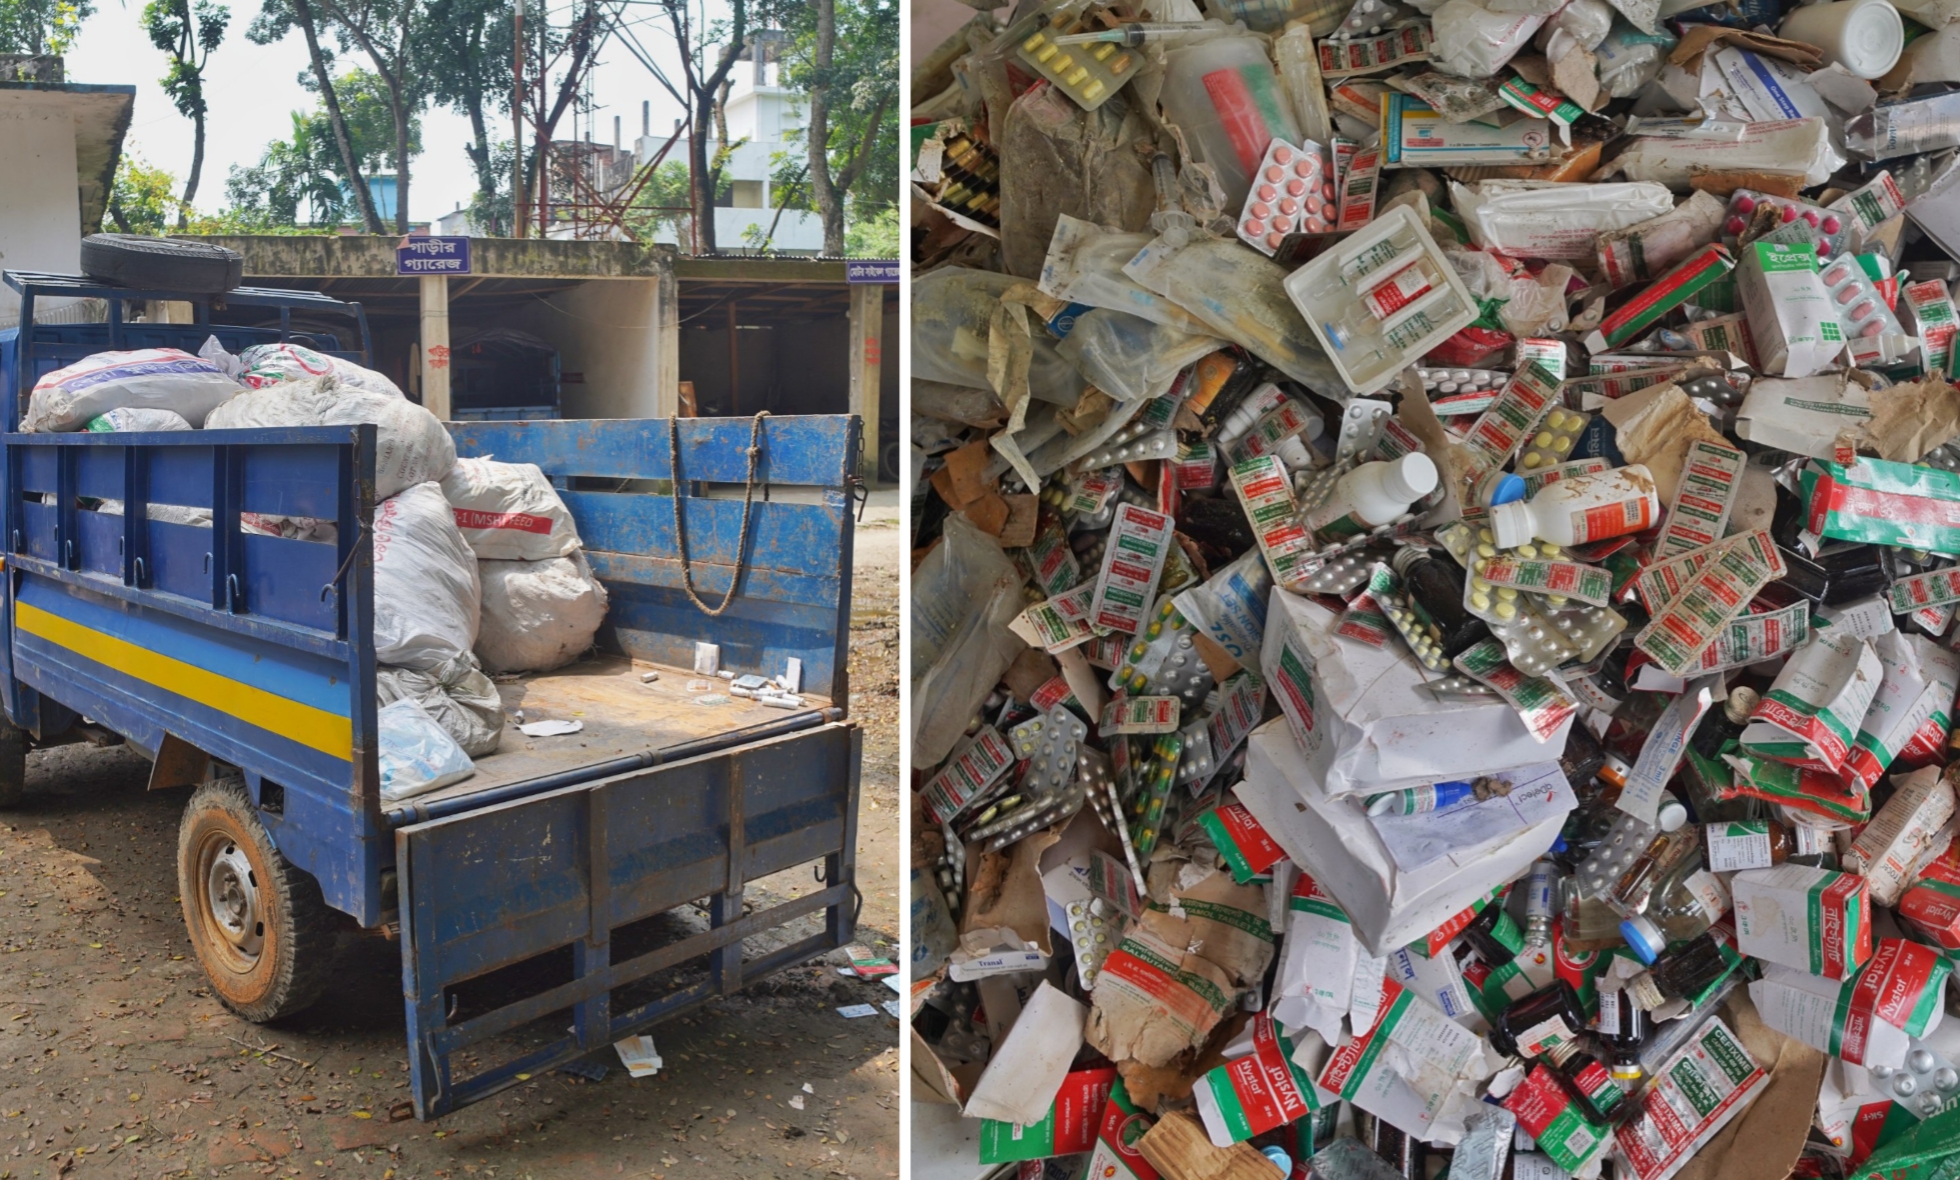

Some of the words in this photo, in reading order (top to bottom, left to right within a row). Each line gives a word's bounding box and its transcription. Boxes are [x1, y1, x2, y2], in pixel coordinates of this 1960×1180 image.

[404, 258, 462, 271] গ্যারেজ
[411, 239, 457, 256] গাড়ীর
[507, 514, 534, 528] FEED
[978, 958, 1004, 968] Tranal
[1864, 946, 1895, 991] Nystat
[1885, 977, 1908, 1018] Nystat
[1711, 1037, 1731, 1060] CAPSULE
[1713, 1029, 1752, 1073] CEFIXIME
[1240, 1059, 1264, 1096] Nystat
[1272, 1065, 1299, 1111] Nystat
[1651, 1091, 1686, 1136] CEFIXIME
